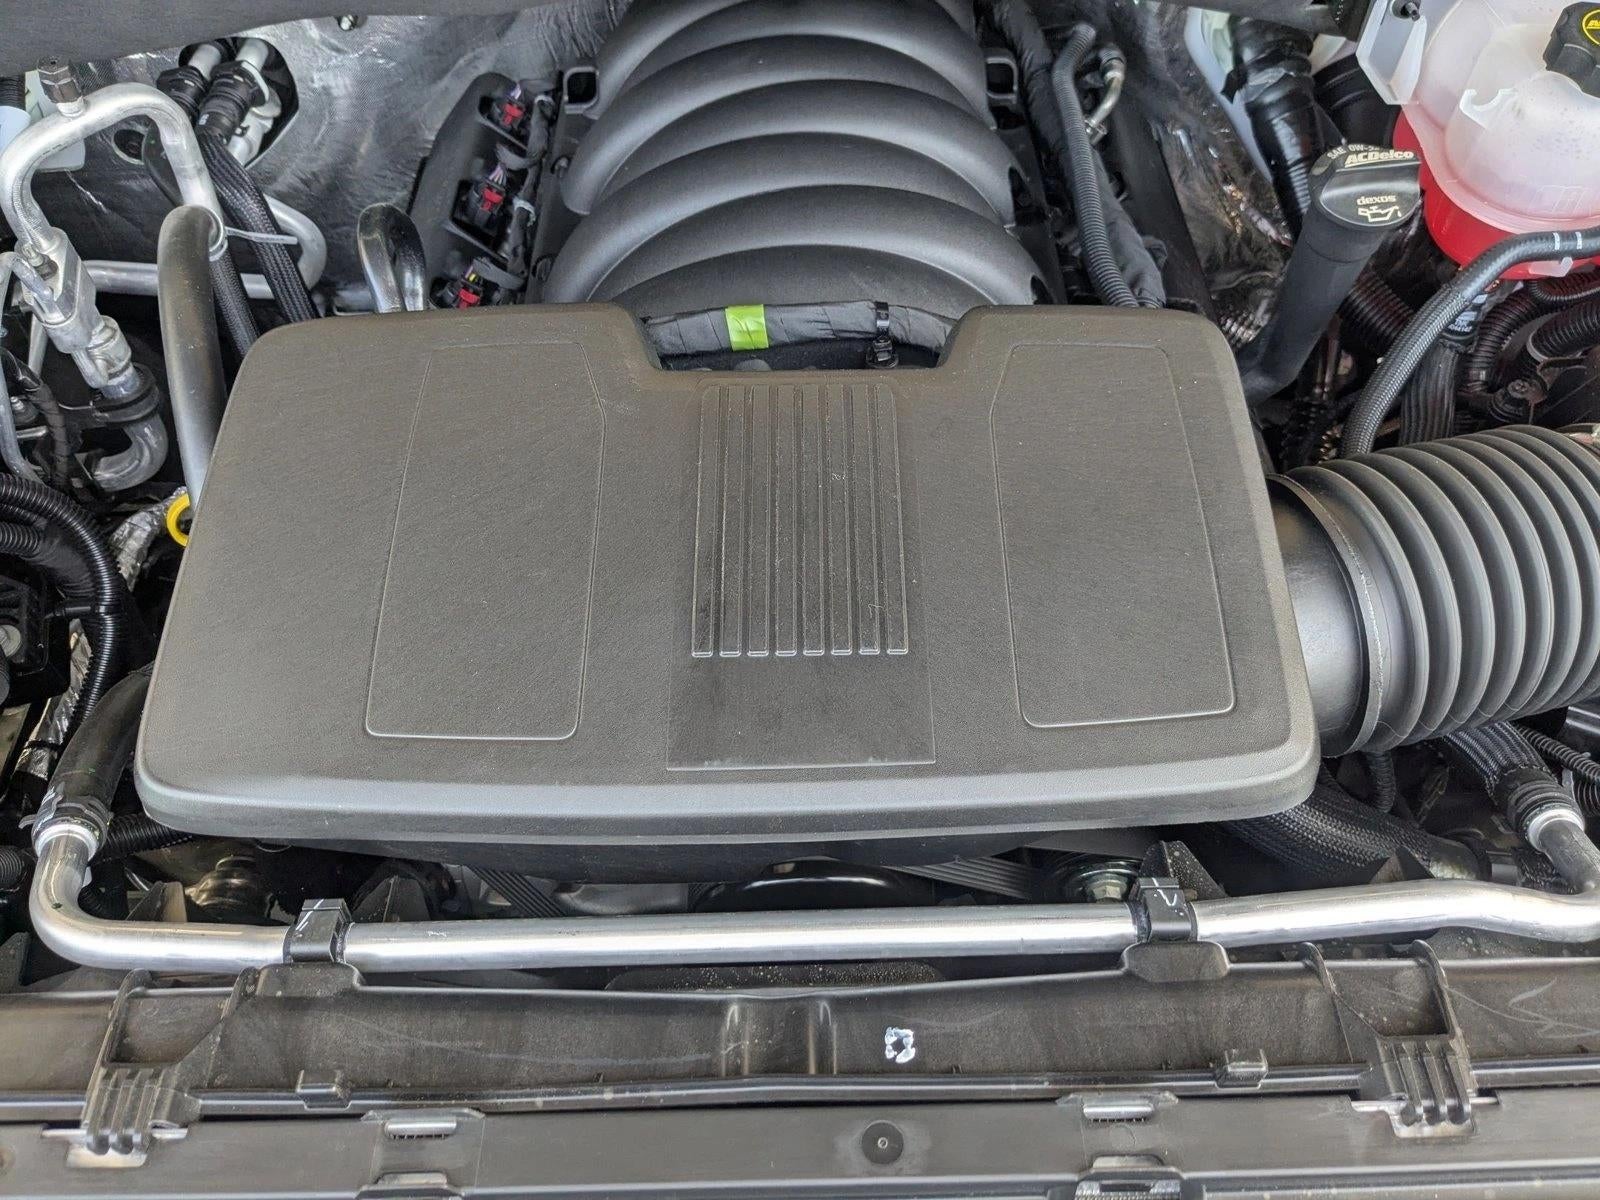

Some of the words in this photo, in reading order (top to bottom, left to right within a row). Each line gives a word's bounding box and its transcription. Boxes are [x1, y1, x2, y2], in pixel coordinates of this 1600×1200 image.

[1326, 146, 1347, 160] SAE
[1344, 149, 1415, 166] ACDelco
[1356, 195, 1396, 206] dexos
